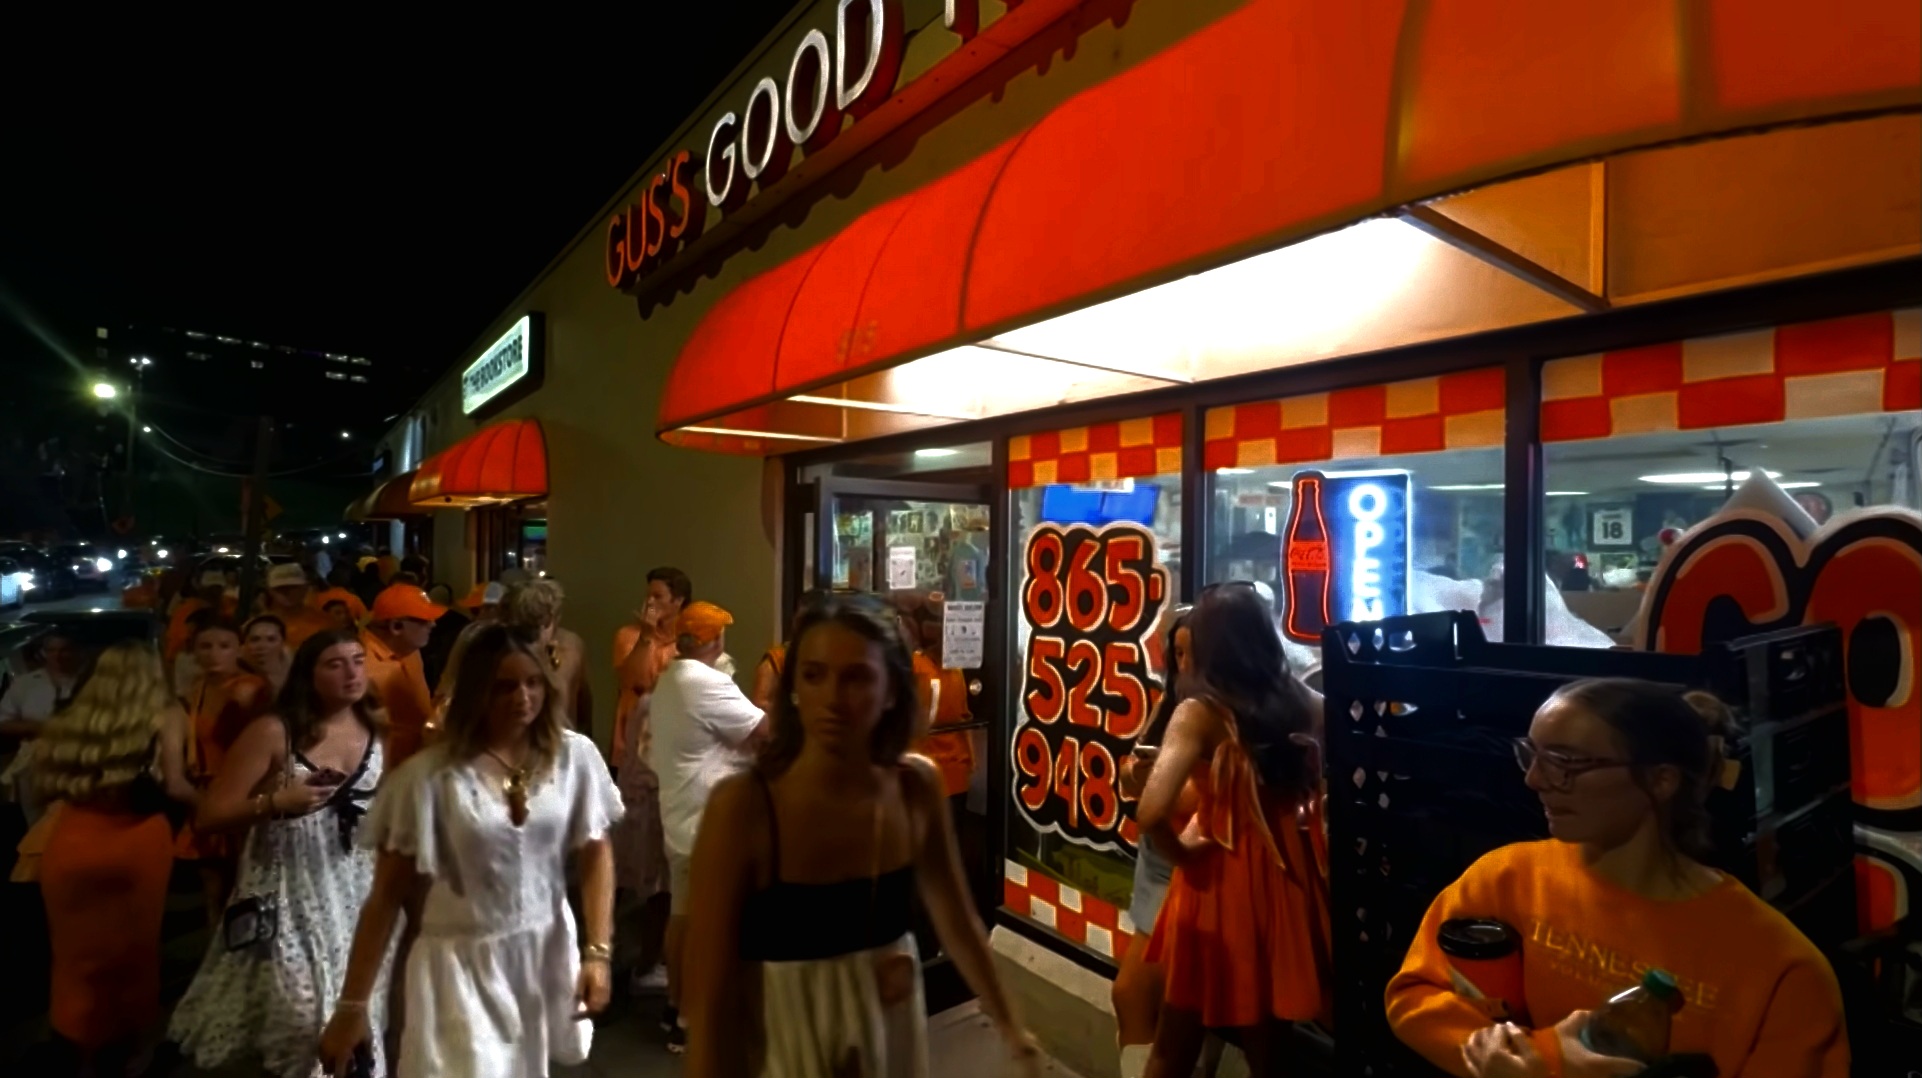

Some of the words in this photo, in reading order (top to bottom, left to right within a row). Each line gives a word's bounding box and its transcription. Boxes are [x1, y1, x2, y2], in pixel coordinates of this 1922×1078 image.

[605, 149, 690, 288] GUS'S
[704, 0, 885, 207] GOOD
[1348, 484, 1388, 622] OPEN
[1602, 521, 1624, 539] 18
[1531, 920, 1718, 1010] TENNESEE
